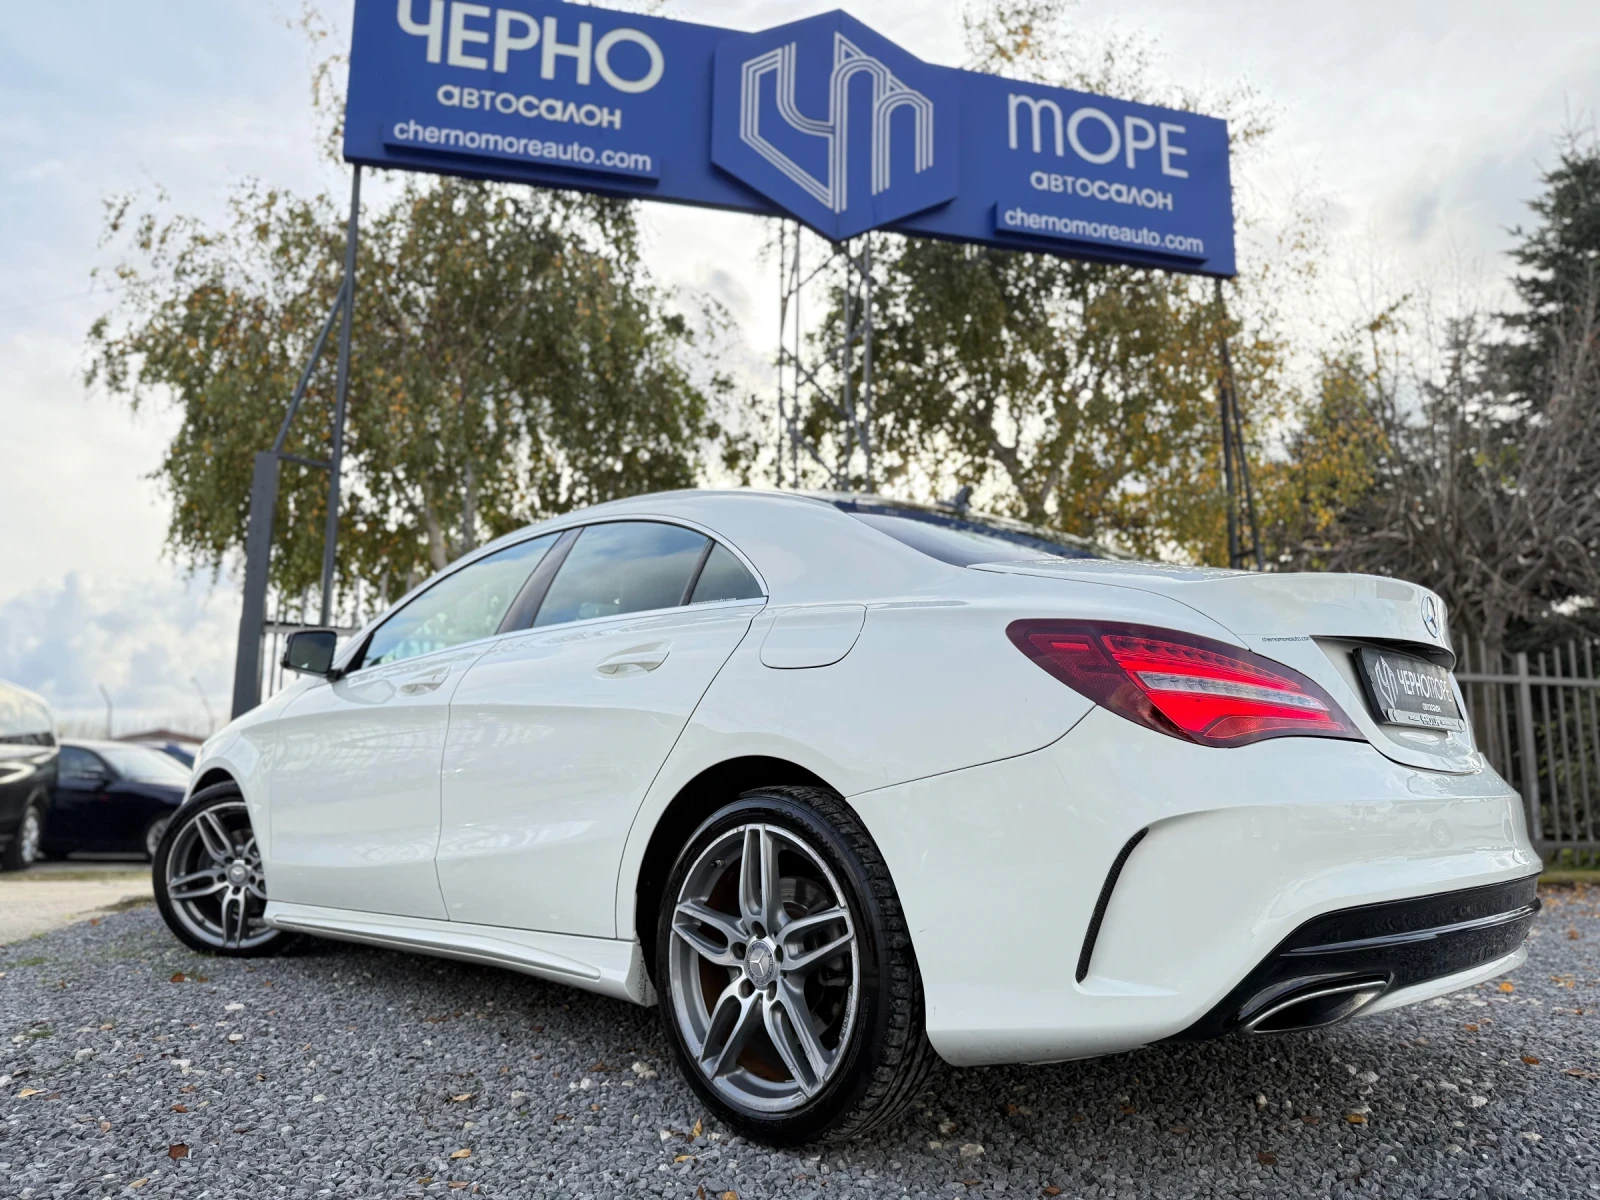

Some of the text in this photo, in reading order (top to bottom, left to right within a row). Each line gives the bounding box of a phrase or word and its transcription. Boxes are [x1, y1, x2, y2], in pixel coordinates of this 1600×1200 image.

[397, 0, 664, 93] ЧЕРНО
[393, 120, 652, 171] chernomoreauto.com
[1008, 93, 1189, 178] МОРЕ
[1004, 207, 1205, 254] chernomoreauto.com
